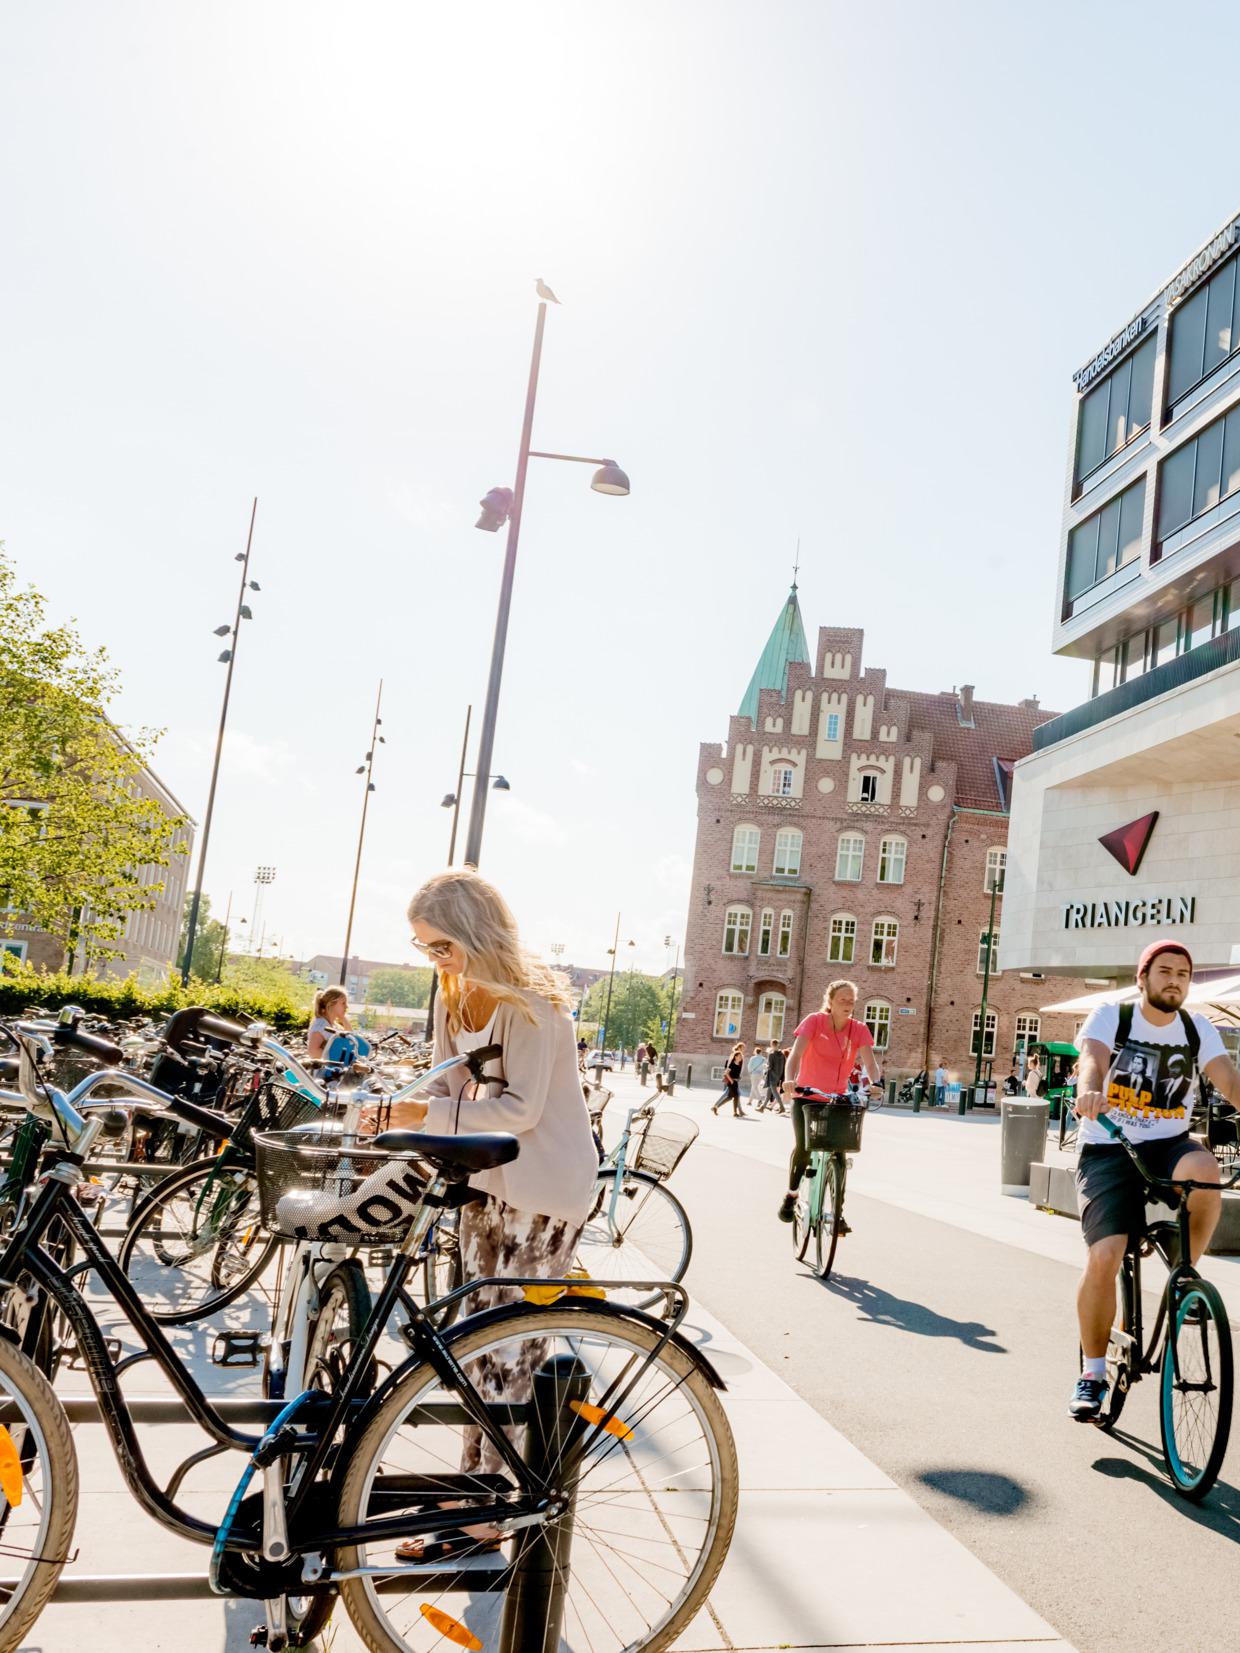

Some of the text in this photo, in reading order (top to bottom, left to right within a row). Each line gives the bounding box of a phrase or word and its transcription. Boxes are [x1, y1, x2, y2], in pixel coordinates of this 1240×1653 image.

[1073, 315, 1147, 393] Handelsbanken
[1060, 897, 1195, 928] TRIANGELN
[1108, 1083, 1153, 1105] PULP
